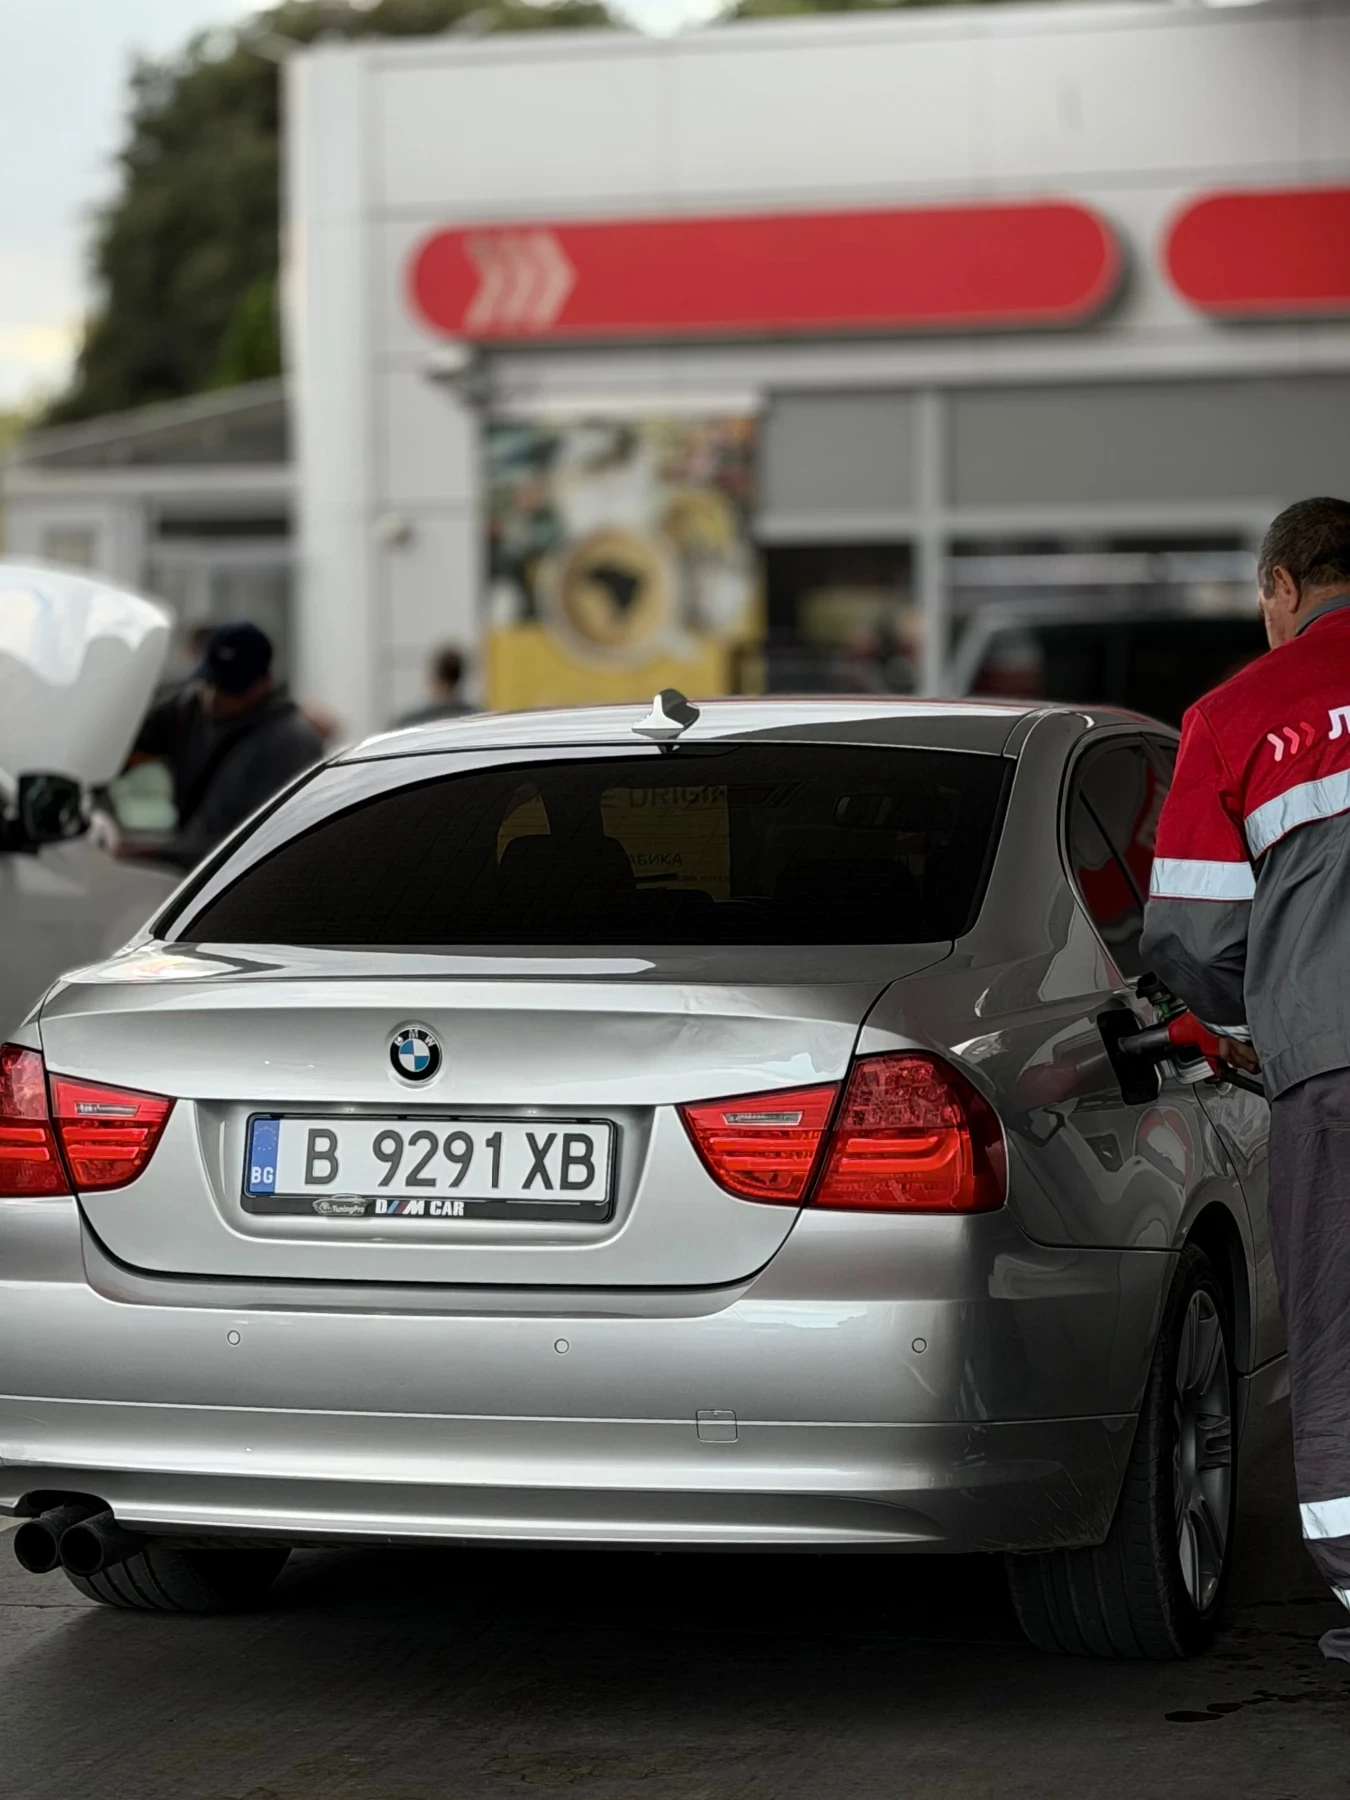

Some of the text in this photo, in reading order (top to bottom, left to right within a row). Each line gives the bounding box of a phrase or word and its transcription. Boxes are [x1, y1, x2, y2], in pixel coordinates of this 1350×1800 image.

[394, 1029, 436, 1047] BMW
[305, 1128, 596, 1191] B 9291 XB
[251, 1166, 274, 1184] BG
[429, 1200, 465, 1216] CAR
